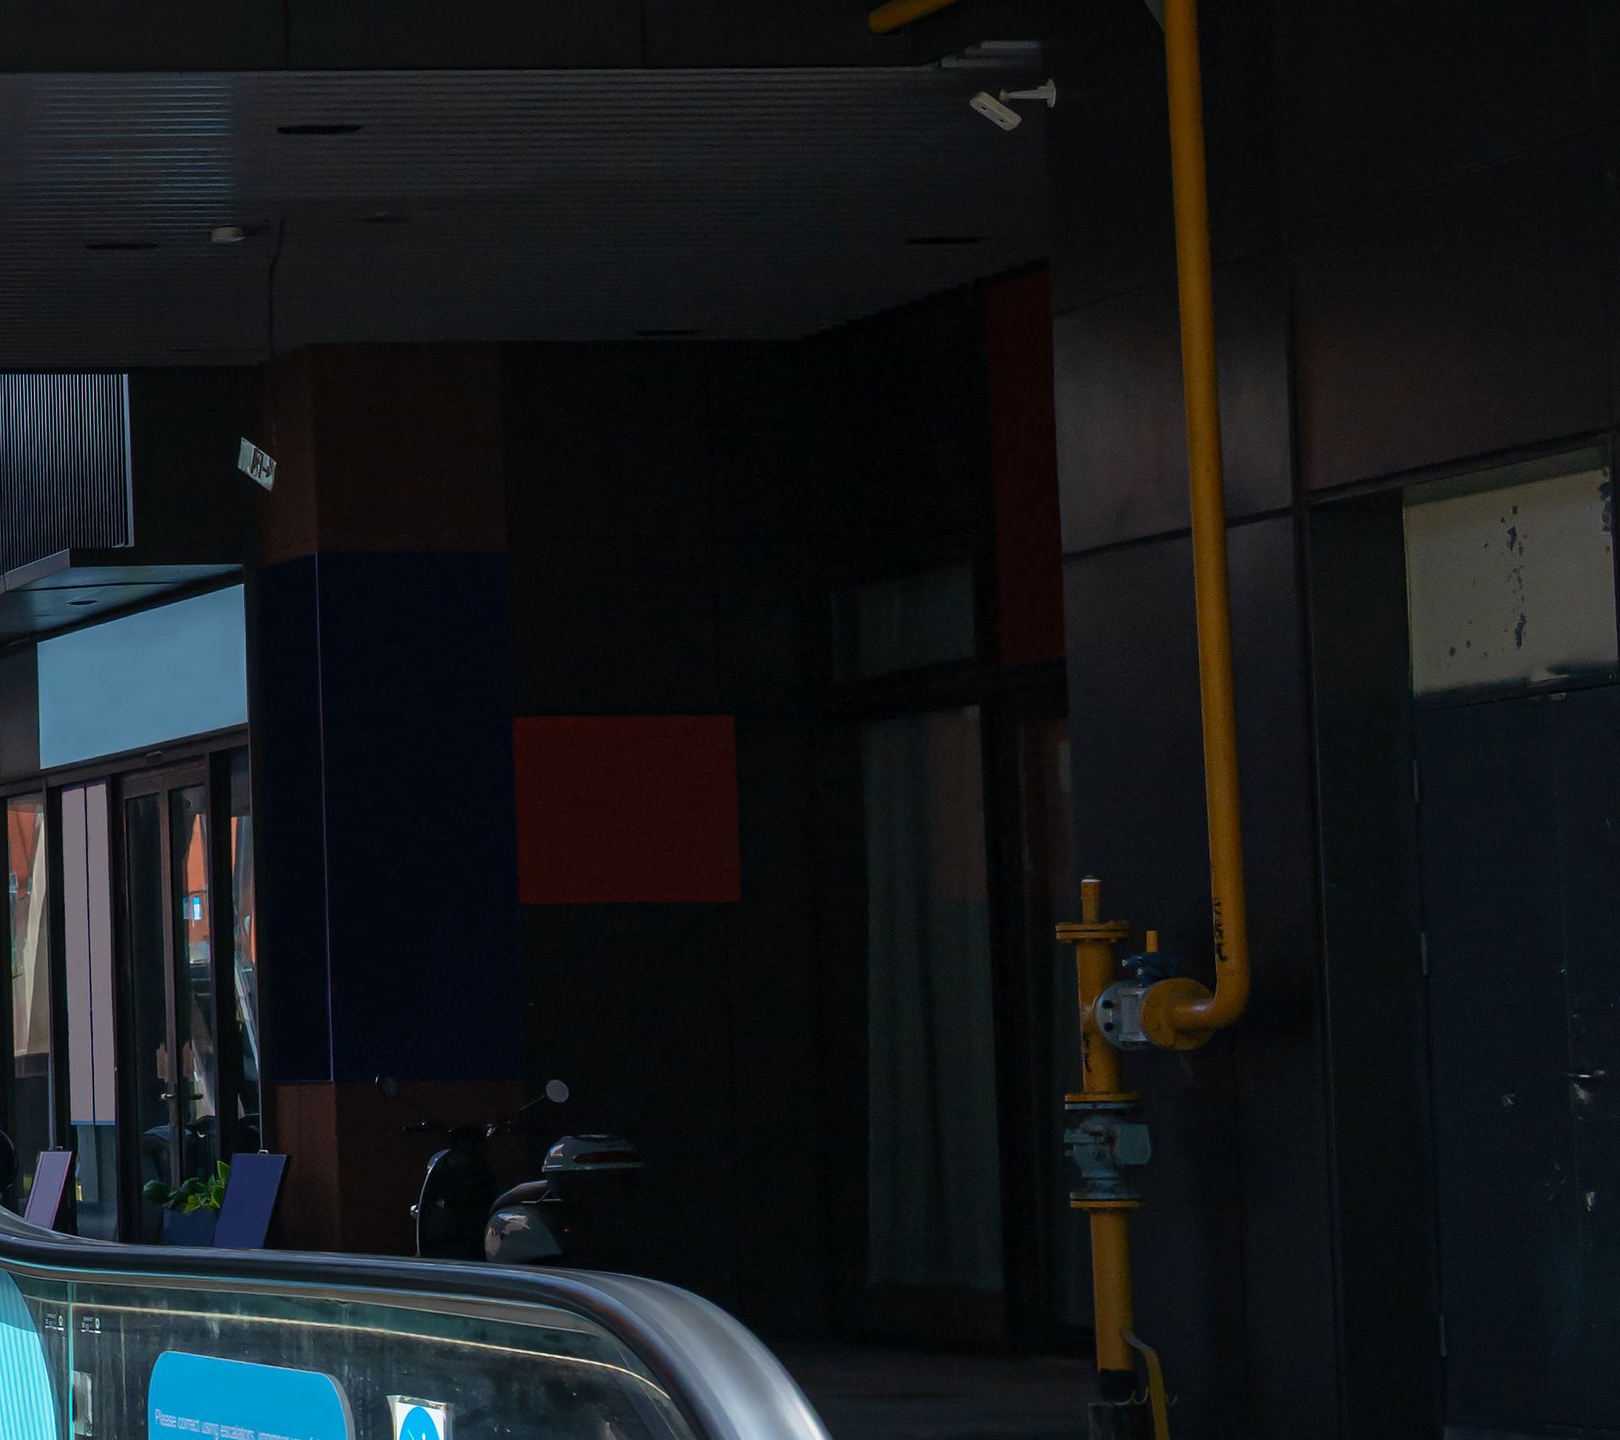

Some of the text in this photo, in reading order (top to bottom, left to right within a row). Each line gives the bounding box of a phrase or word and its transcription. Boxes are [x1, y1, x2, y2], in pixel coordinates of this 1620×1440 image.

[155, 1408, 177, 1429] Please
[178, 1416, 200, 1433] correct
[201, 1421, 219, 1440] using
